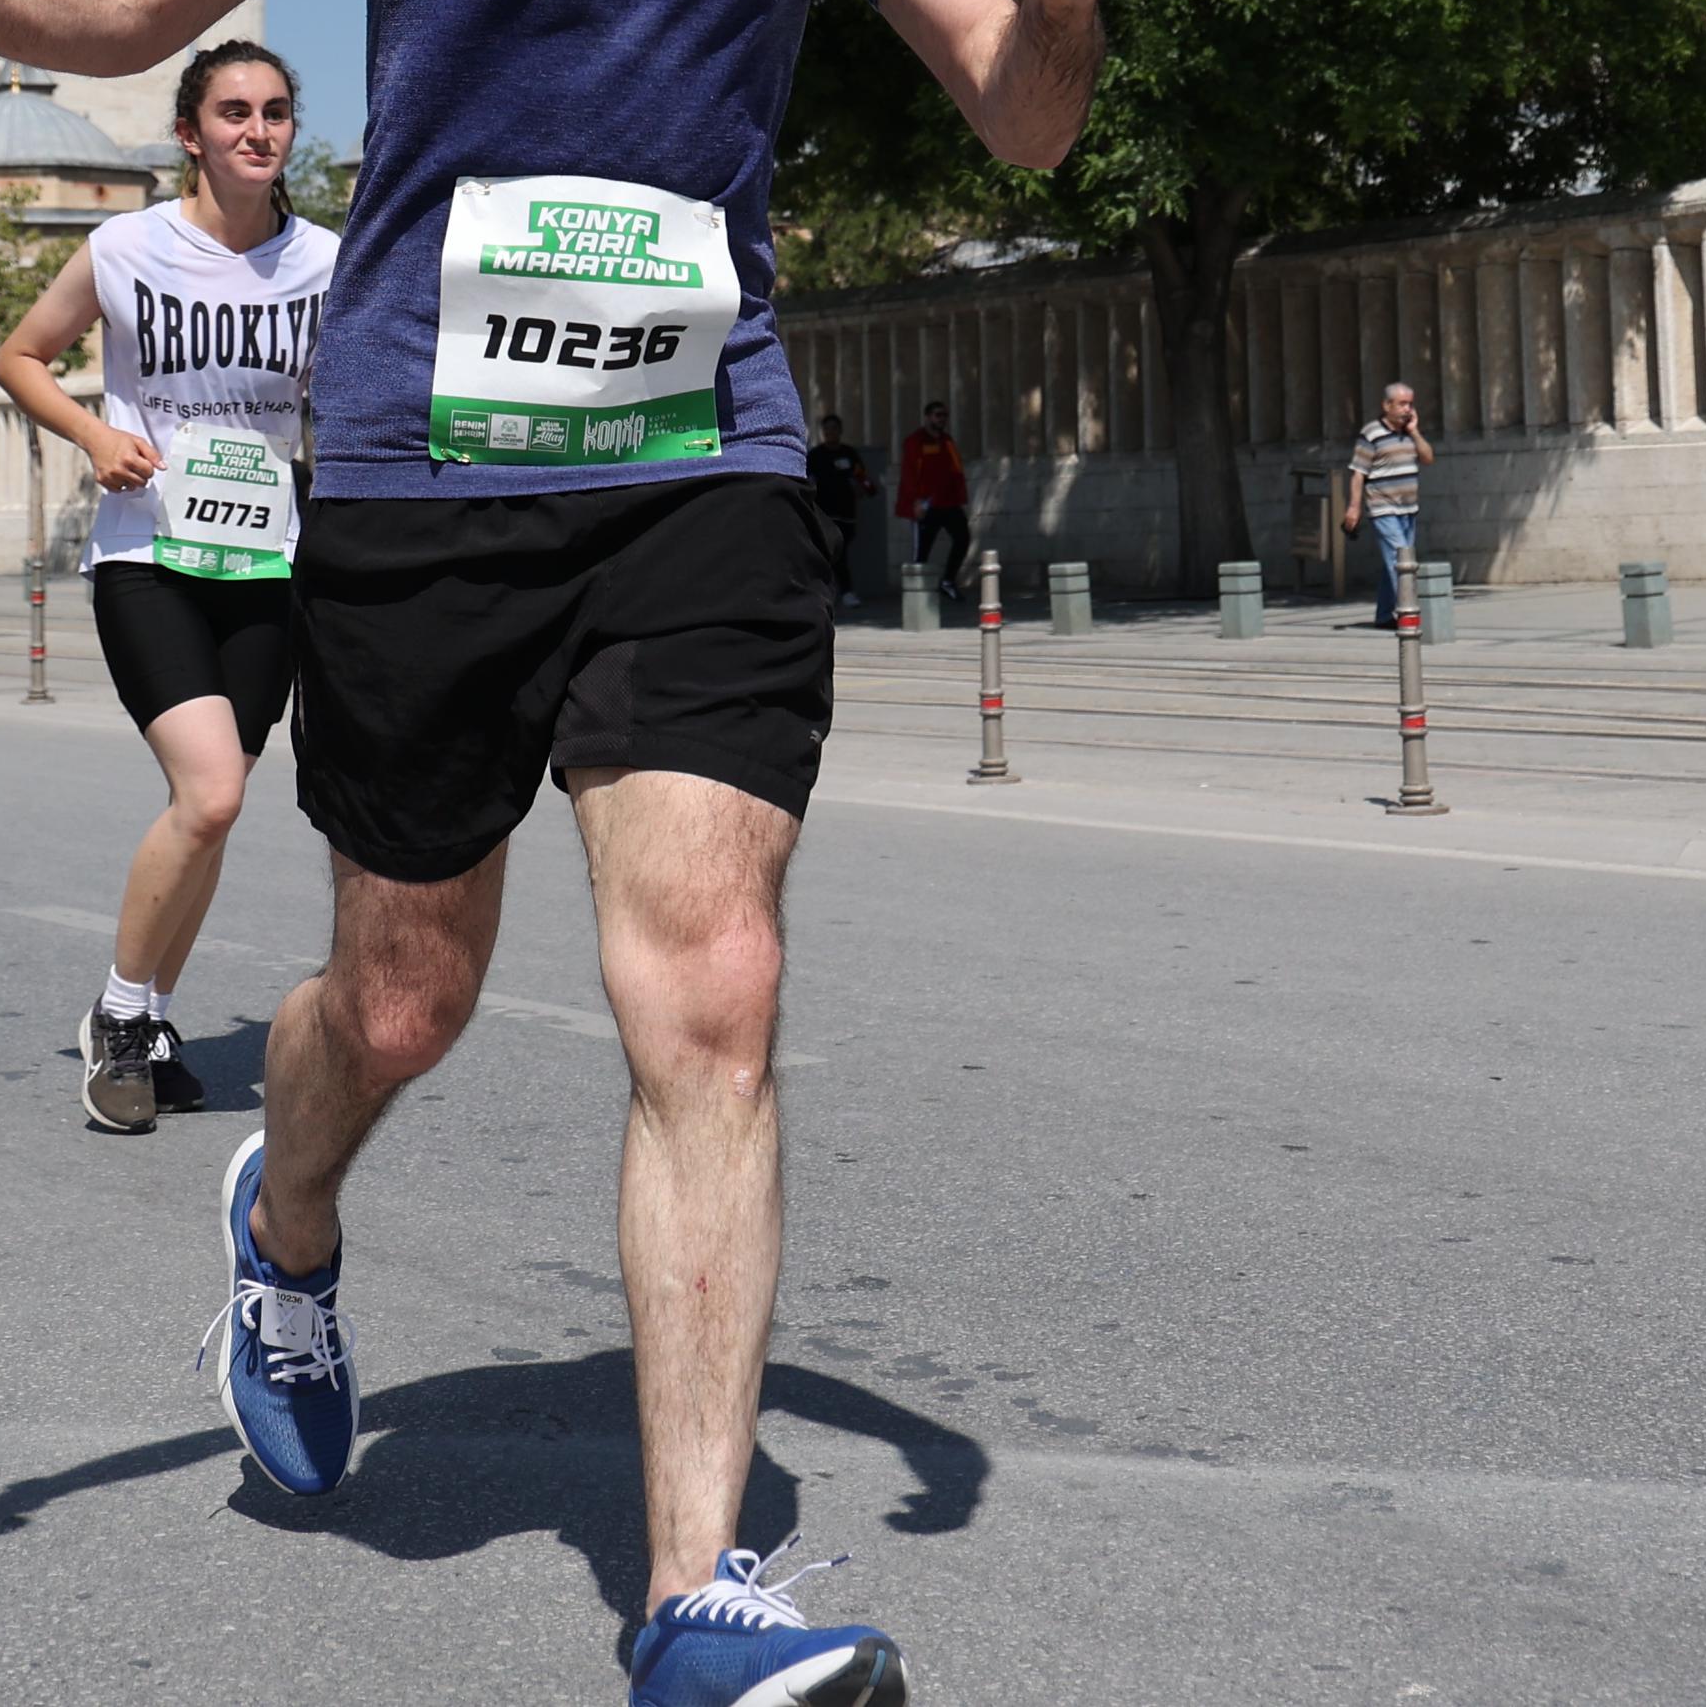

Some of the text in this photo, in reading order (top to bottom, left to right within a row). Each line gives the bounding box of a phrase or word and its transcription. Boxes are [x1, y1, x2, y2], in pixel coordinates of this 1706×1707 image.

[537, 206, 653, 237] KONYA
[555, 229, 636, 255] YARI
[493, 250, 689, 282] MARATONU
[483, 313, 689, 371] 10236
[143, 394, 296, 419] LIFE IS SHORT BE HAP
[213, 442, 263, 459] KONYA
[221, 454, 255, 469] YARI
[192, 462, 275, 483] MARATONU
[184, 496, 271, 530] 10773
[276, 1292, 303, 1304] 10236
